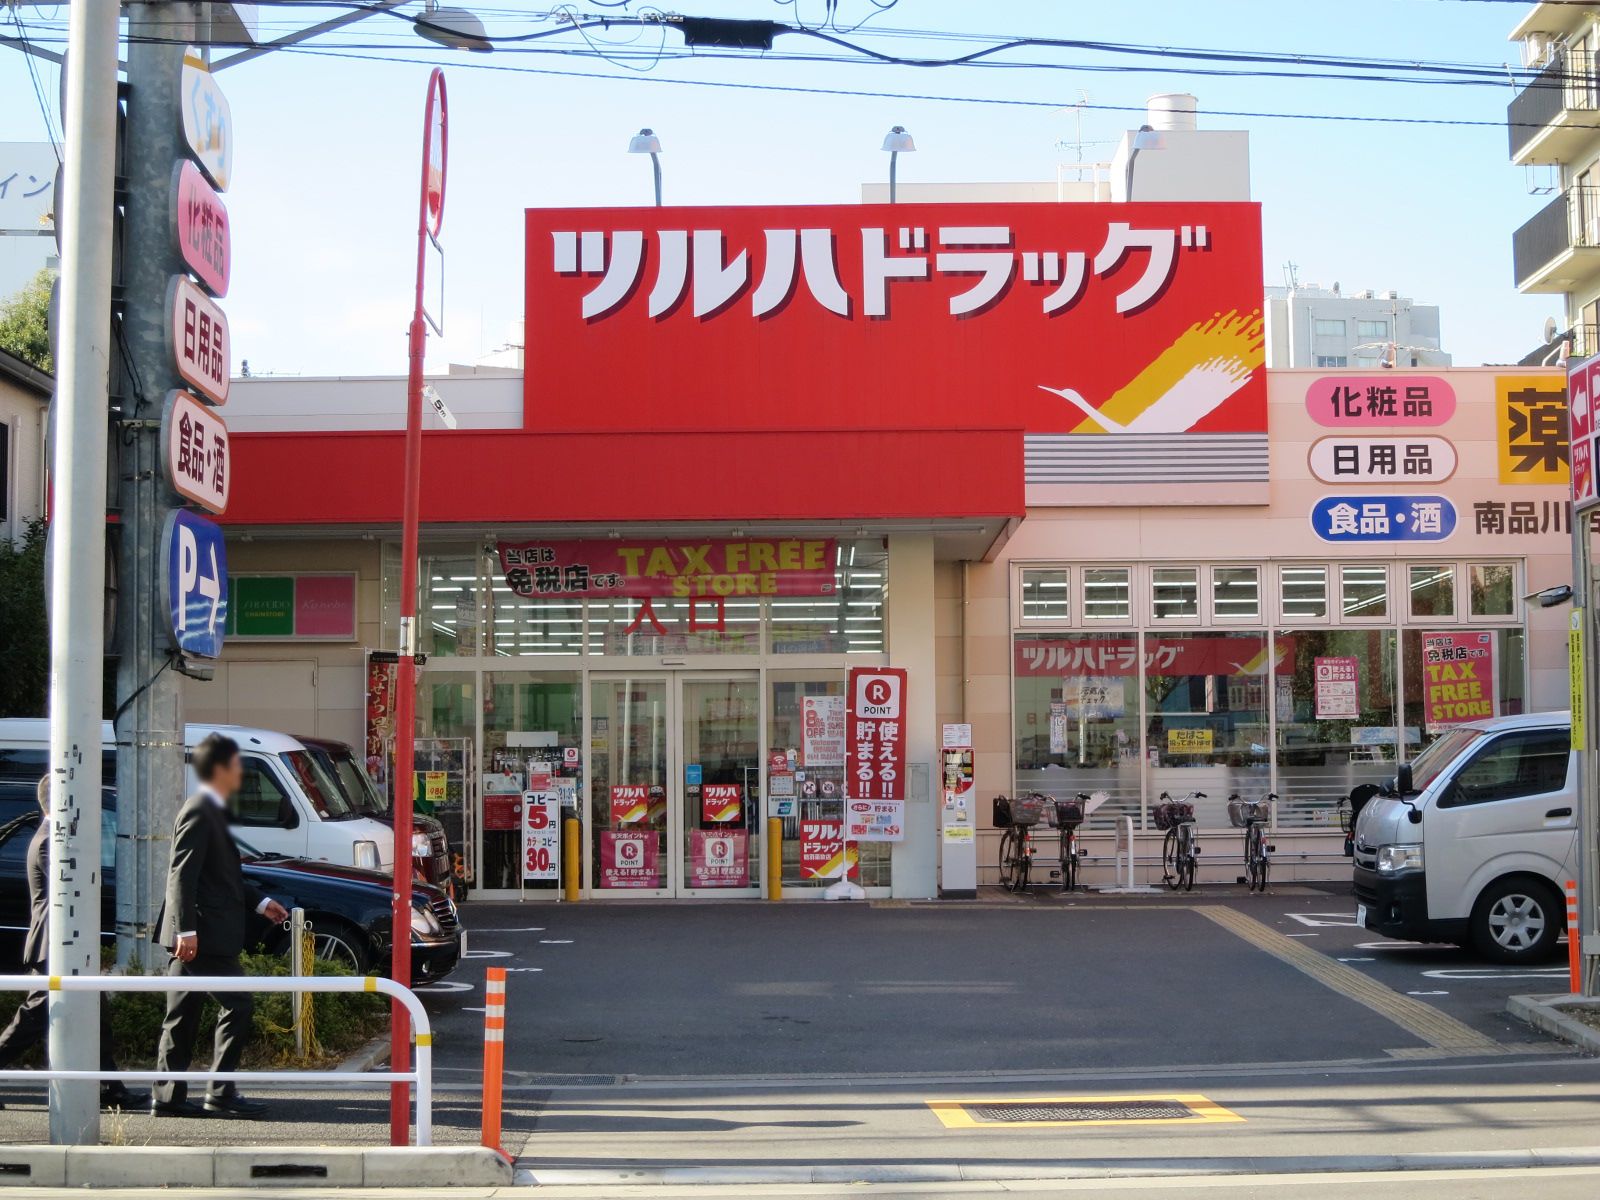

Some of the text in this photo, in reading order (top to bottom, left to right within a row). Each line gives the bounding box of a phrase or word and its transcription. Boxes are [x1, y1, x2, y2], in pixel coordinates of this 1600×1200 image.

[188, 184, 224, 279] 化粧品
[551, 222, 1209, 318] ツルハドラッグ
[184, 298, 223, 386] 日用品
[1331, 386, 1432, 417] 化粧品
[1508, 388, 1569, 472] 薬
[178, 411, 225, 496] 食品・酒
[1333, 444, 1432, 476] 日用品
[1574, 445, 1589, 462] ツルハ
[1327, 502, 1441, 535] 食品・酒
[506, 547, 554, 565] 当店は
[618, 541, 827, 577] TAX FREE
[179, 524, 197, 631] P
[505, 564, 626, 594] 免税店です。
[673, 573, 778, 597] STORE
[624, 597, 726, 635] 入口
[1427, 638, 1452, 646] 当店は
[1022, 644, 1184, 671] ツルハドラッグ
[1428, 646, 1488, 661] 免税店です。
[1426, 662, 1477, 682] TAX
[873, 685, 884, 700] R
[1430, 681, 1482, 703] FREE
[864, 706, 891, 715] POINT
[1432, 700, 1491, 720] STORE
[856, 722, 876, 797] 貯まる!!
[878, 721, 898, 797] 使える!!
[527, 794, 556, 805] コピー
[613, 787, 645, 798] ツルハ
[613, 798, 639, 806] ドラッグ
[705, 786, 737, 797] ツルハ
[705, 798, 730, 806] ドラッグ
[625, 847, 635, 857] R
[716, 846, 725, 856] R
[803, 842, 842, 853] ドラッグ
